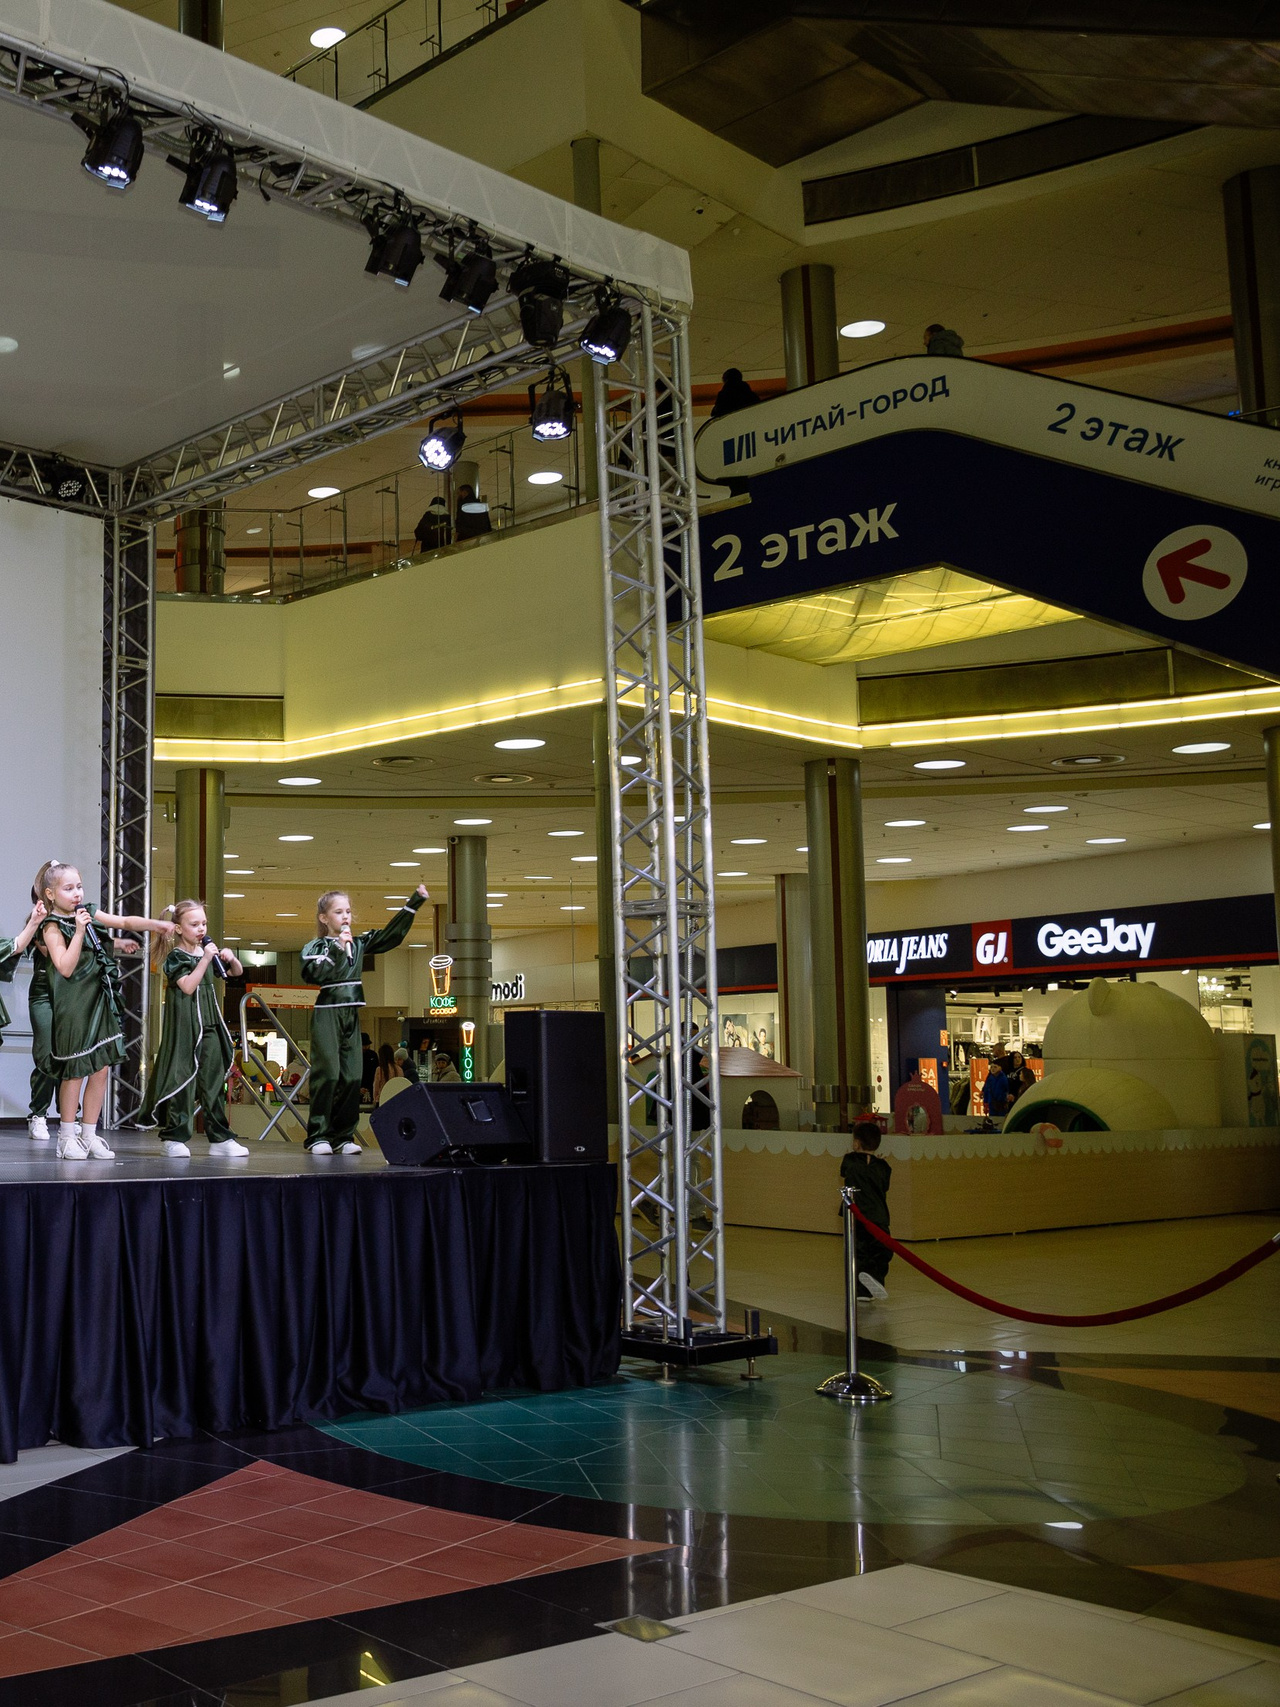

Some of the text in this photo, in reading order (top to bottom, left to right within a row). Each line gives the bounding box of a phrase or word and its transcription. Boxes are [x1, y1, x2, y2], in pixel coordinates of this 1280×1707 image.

[764, 375, 950, 446] ЧИТАЙ-ГОРОД
[1048, 402, 1185, 461] 2 этаж
[711, 502, 899, 582] 2 этаж
[895, 933, 948, 974] JEANS
[976, 932, 1007, 965] GJ
[1037, 917, 1156, 958] GeeJay
[430, 996, 455, 1008] КОФЕ
[492, 973, 525, 1001] modi
[464, 1047, 473, 1083] КОФ
[973, 1092, 984, 1103] S
